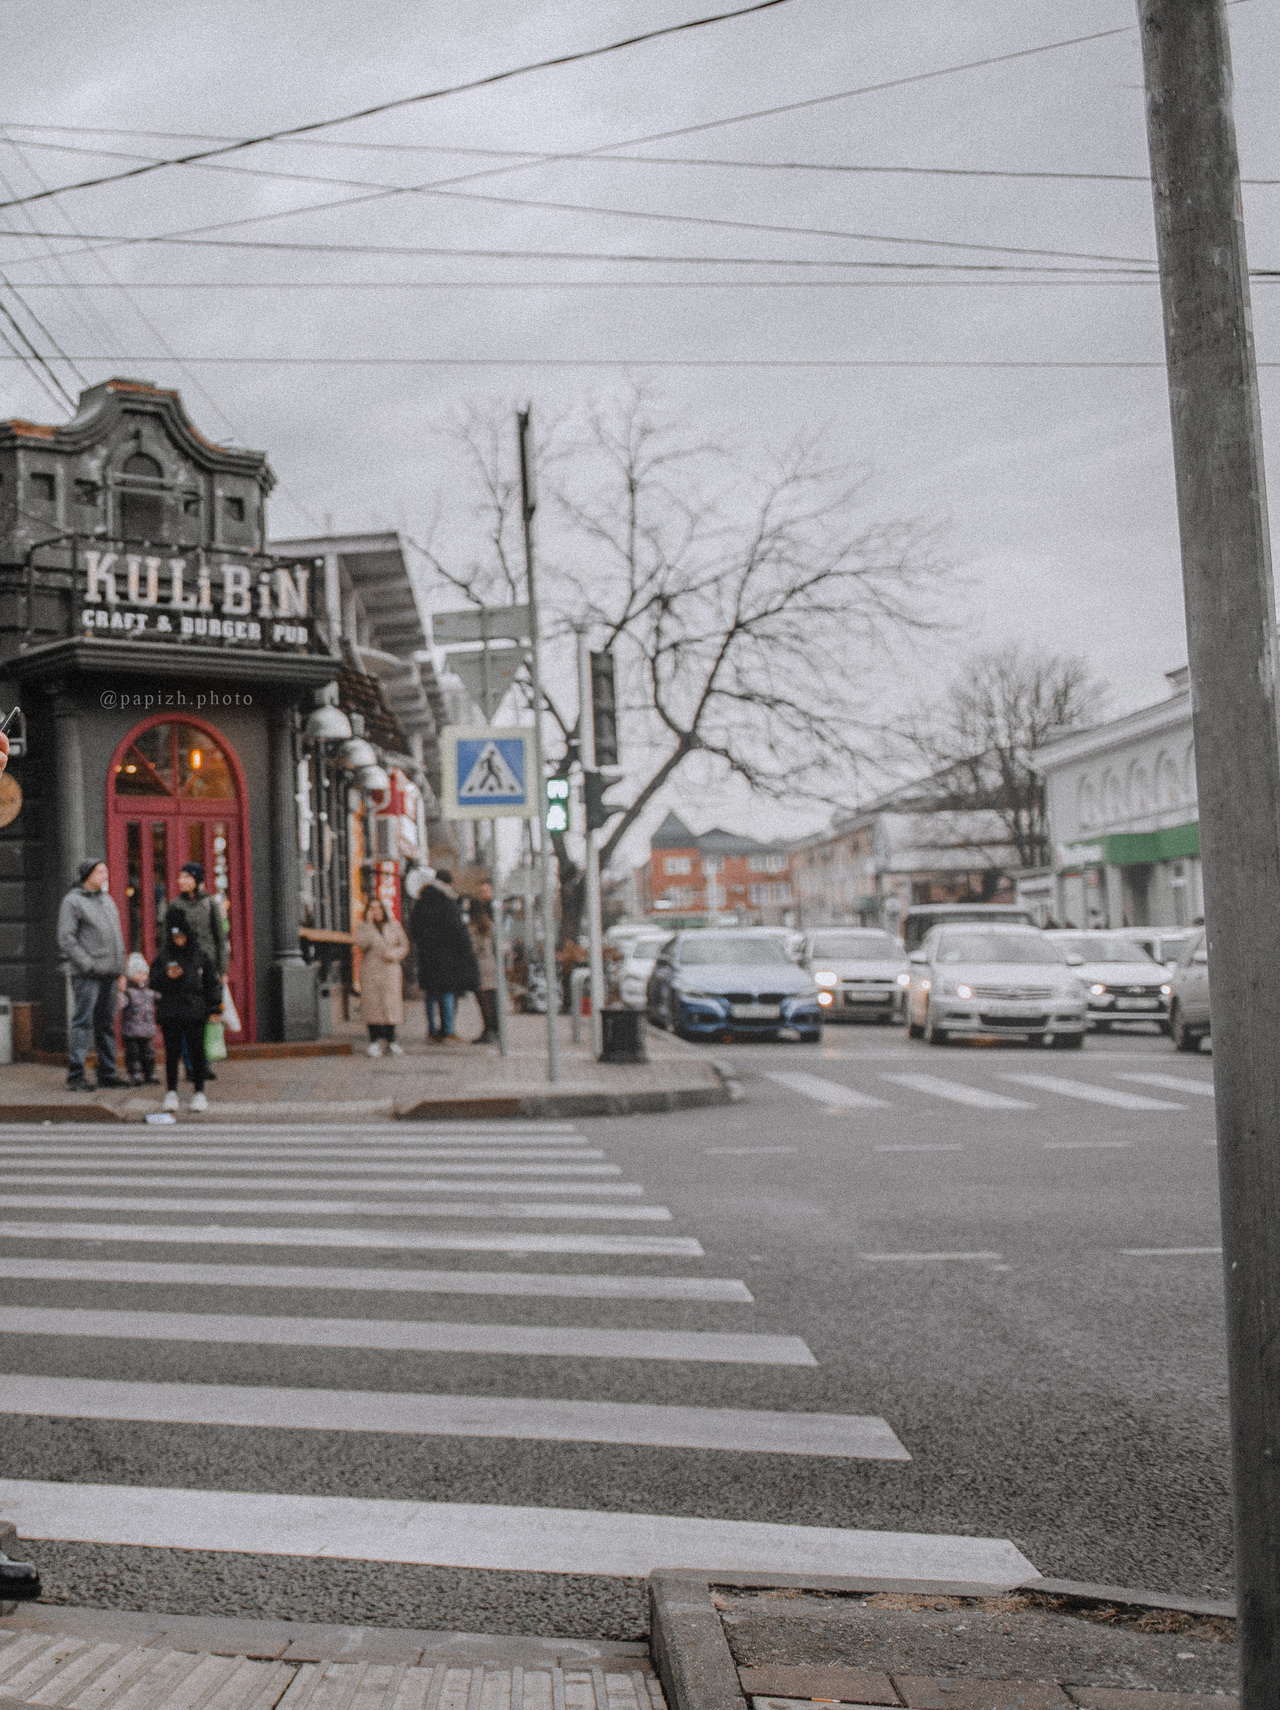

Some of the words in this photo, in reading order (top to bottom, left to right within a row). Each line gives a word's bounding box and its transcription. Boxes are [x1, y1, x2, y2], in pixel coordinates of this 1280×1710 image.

[81, 609, 149, 630] CRAFT
[157, 615, 173, 632] &
[180, 616, 261, 640] BURGER
